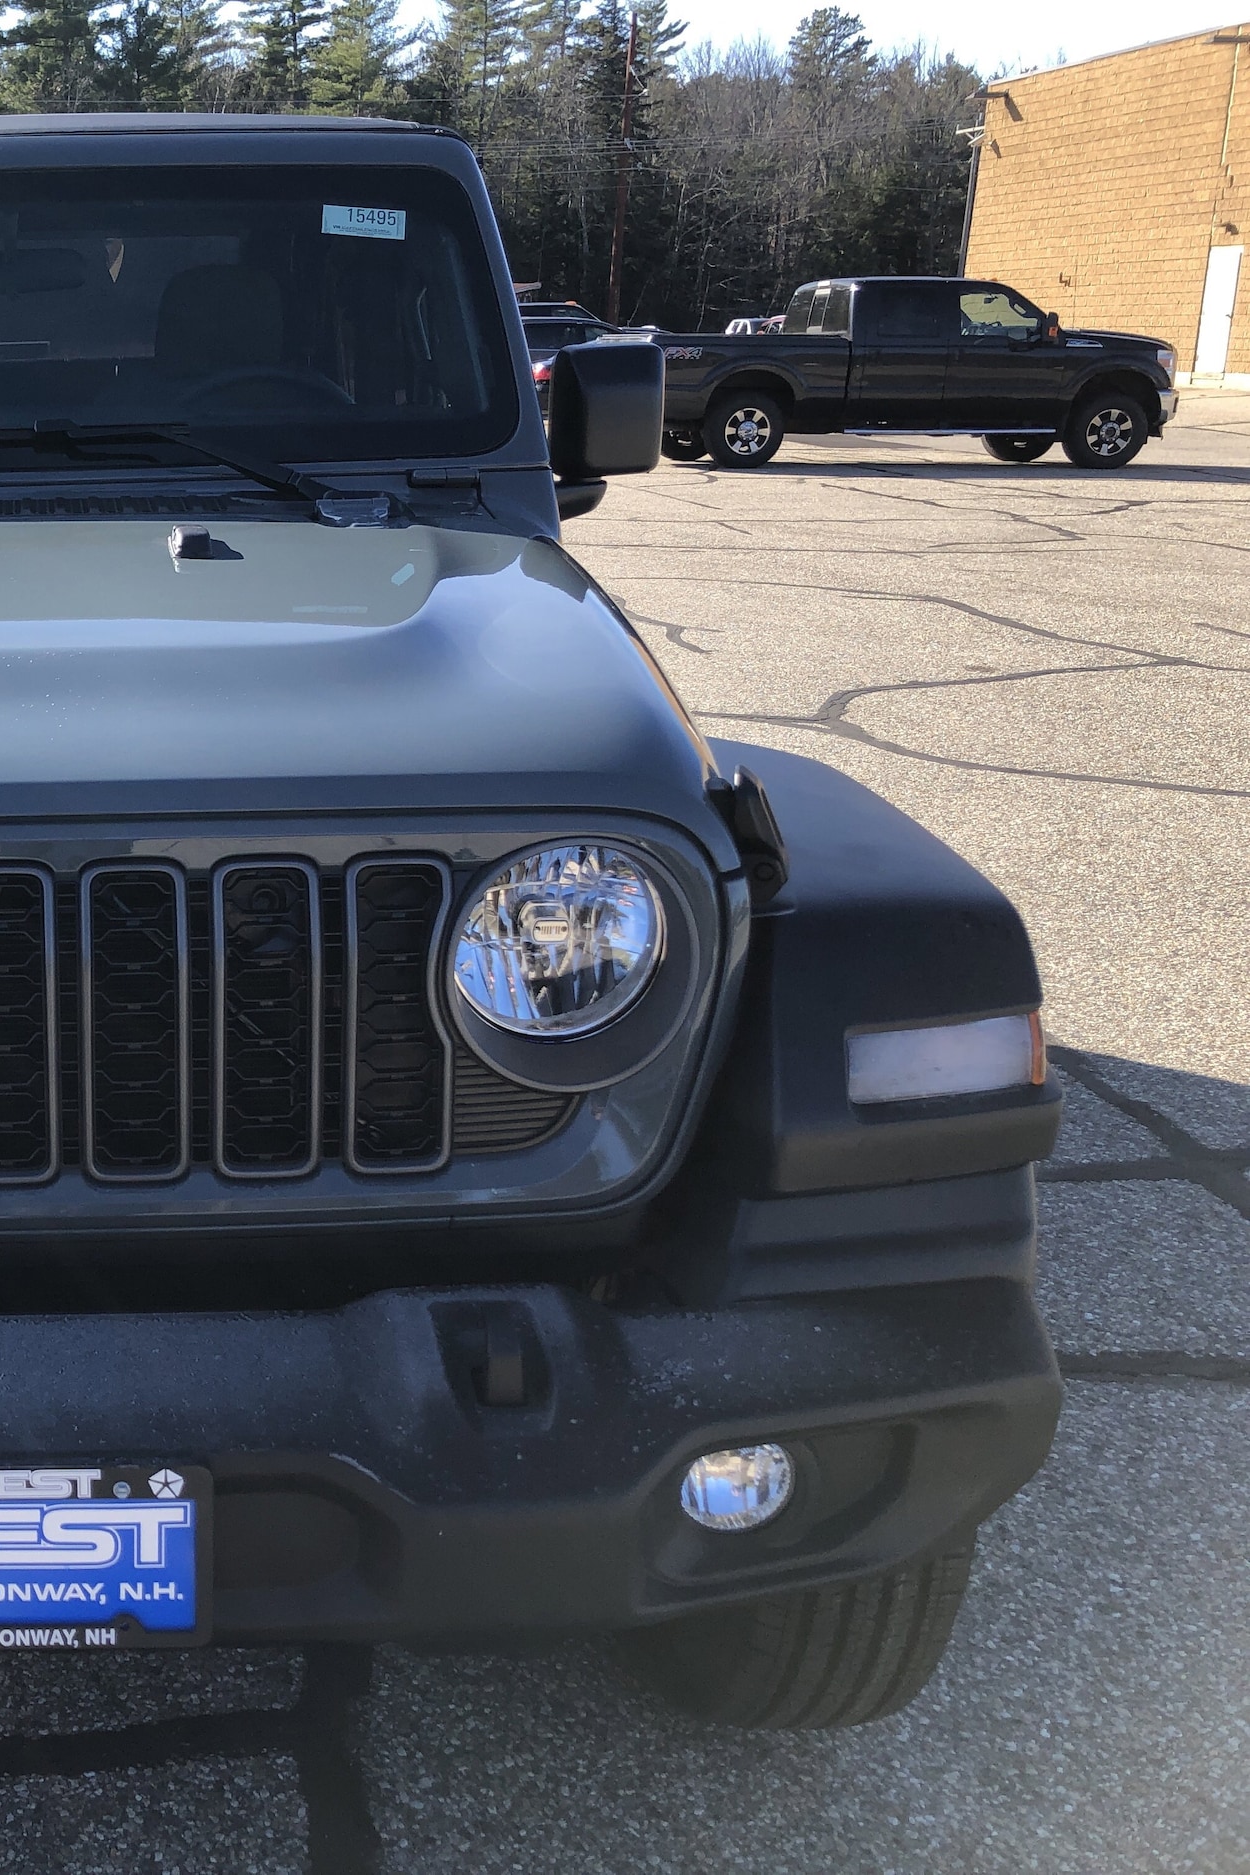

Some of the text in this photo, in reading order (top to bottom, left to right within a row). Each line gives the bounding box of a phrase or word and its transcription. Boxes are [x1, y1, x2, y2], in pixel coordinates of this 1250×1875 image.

[348, 208, 396, 226] 15495
[118, 1581, 185, 1601] N.H.
[84, 1627, 117, 1646] NH
